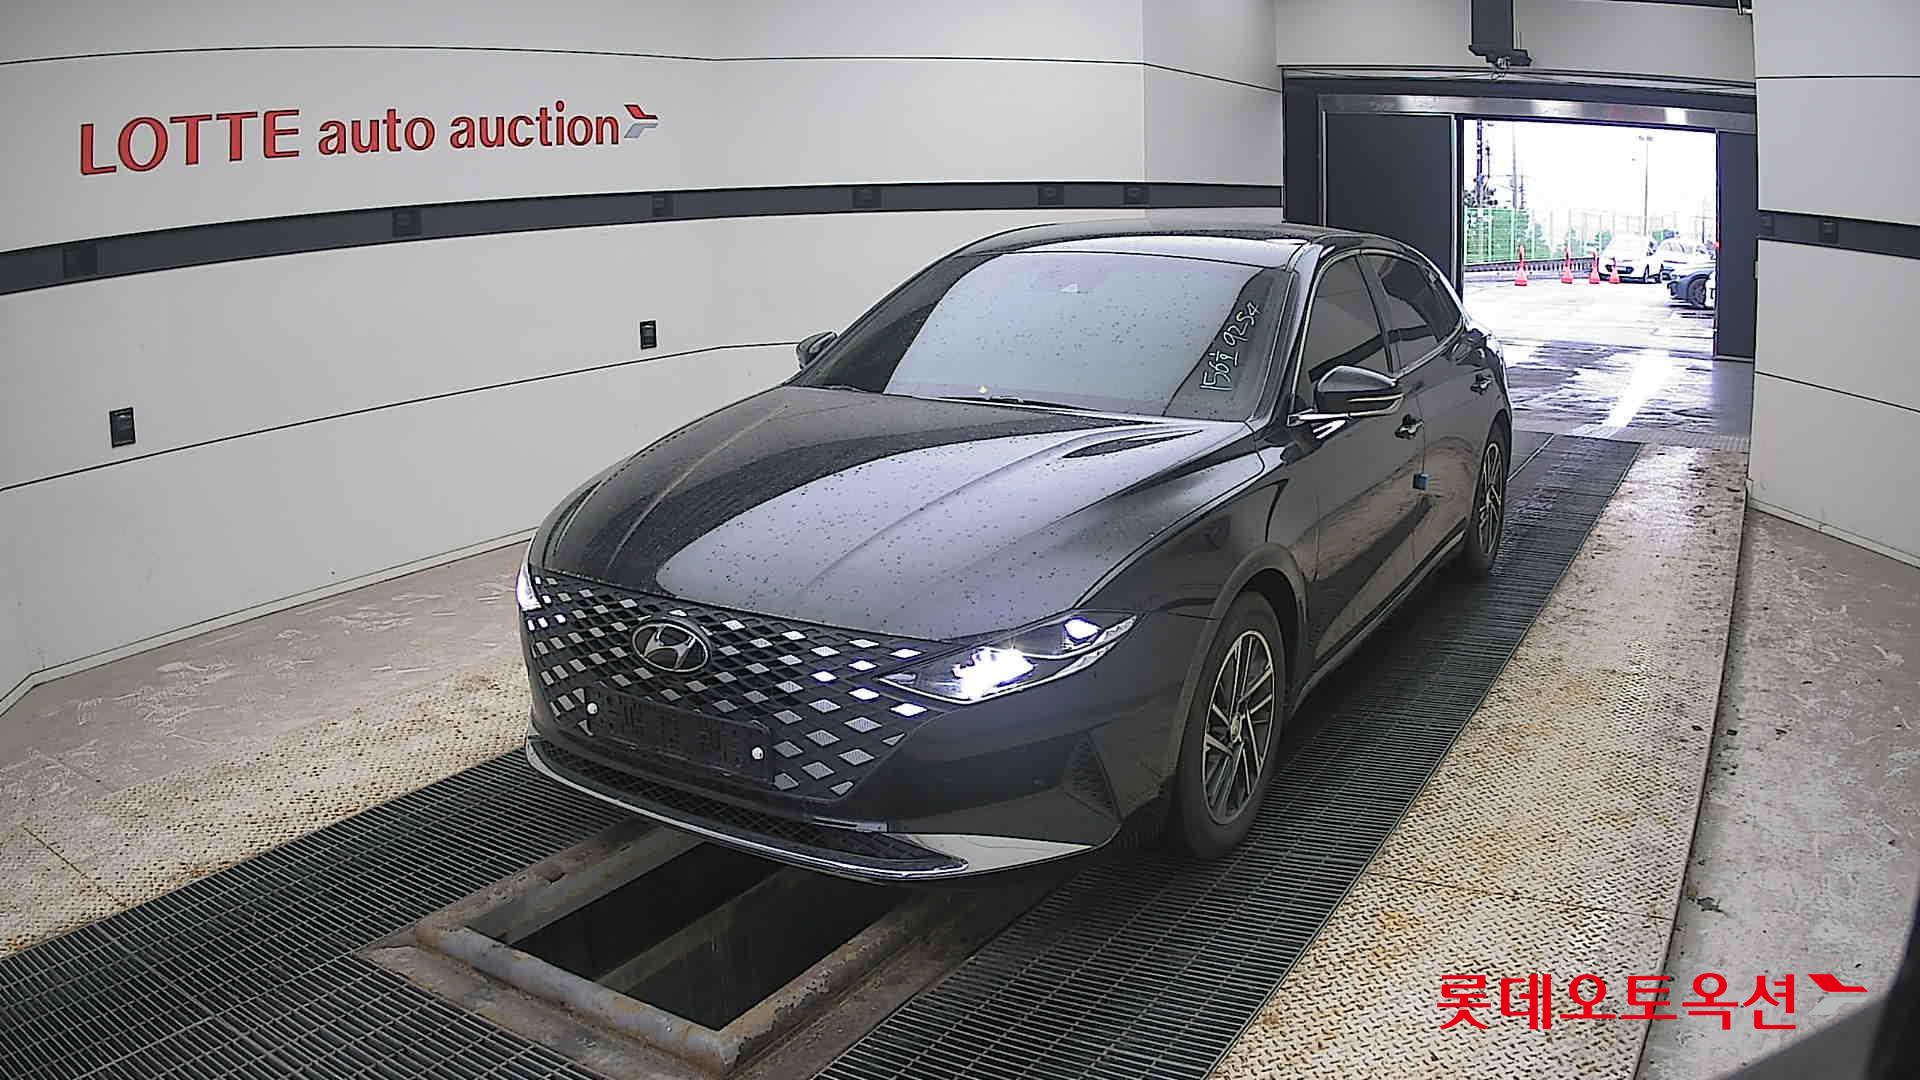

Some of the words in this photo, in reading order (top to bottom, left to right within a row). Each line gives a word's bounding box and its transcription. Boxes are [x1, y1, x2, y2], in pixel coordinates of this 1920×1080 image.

[80, 109, 301, 176] LOTTE
[317, 108, 437, 156] auto
[449, 100, 620, 149] auction
